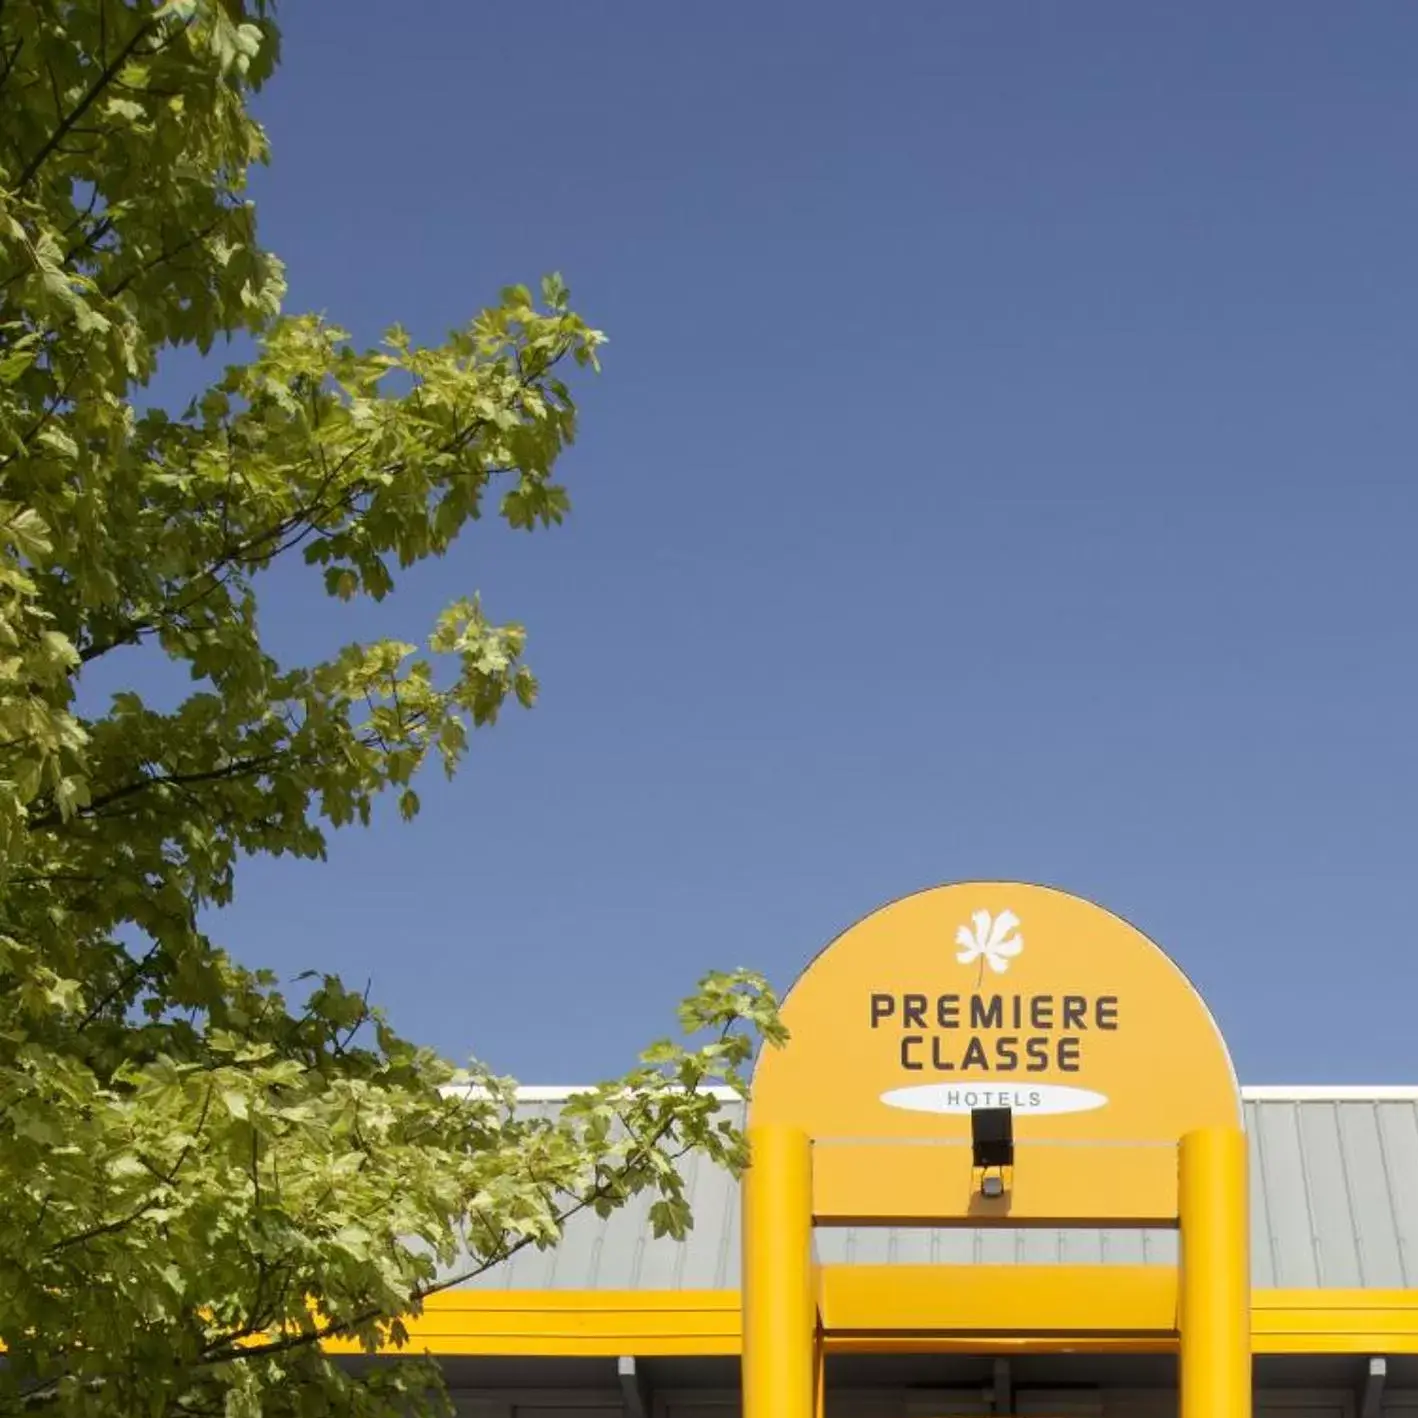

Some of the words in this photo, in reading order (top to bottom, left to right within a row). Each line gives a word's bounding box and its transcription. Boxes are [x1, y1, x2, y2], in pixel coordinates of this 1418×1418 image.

[870, 993, 1119, 1031] PREMIERE
[900, 1036, 1081, 1072] CLASSE
[947, 1090, 1042, 1108] HOTELS
